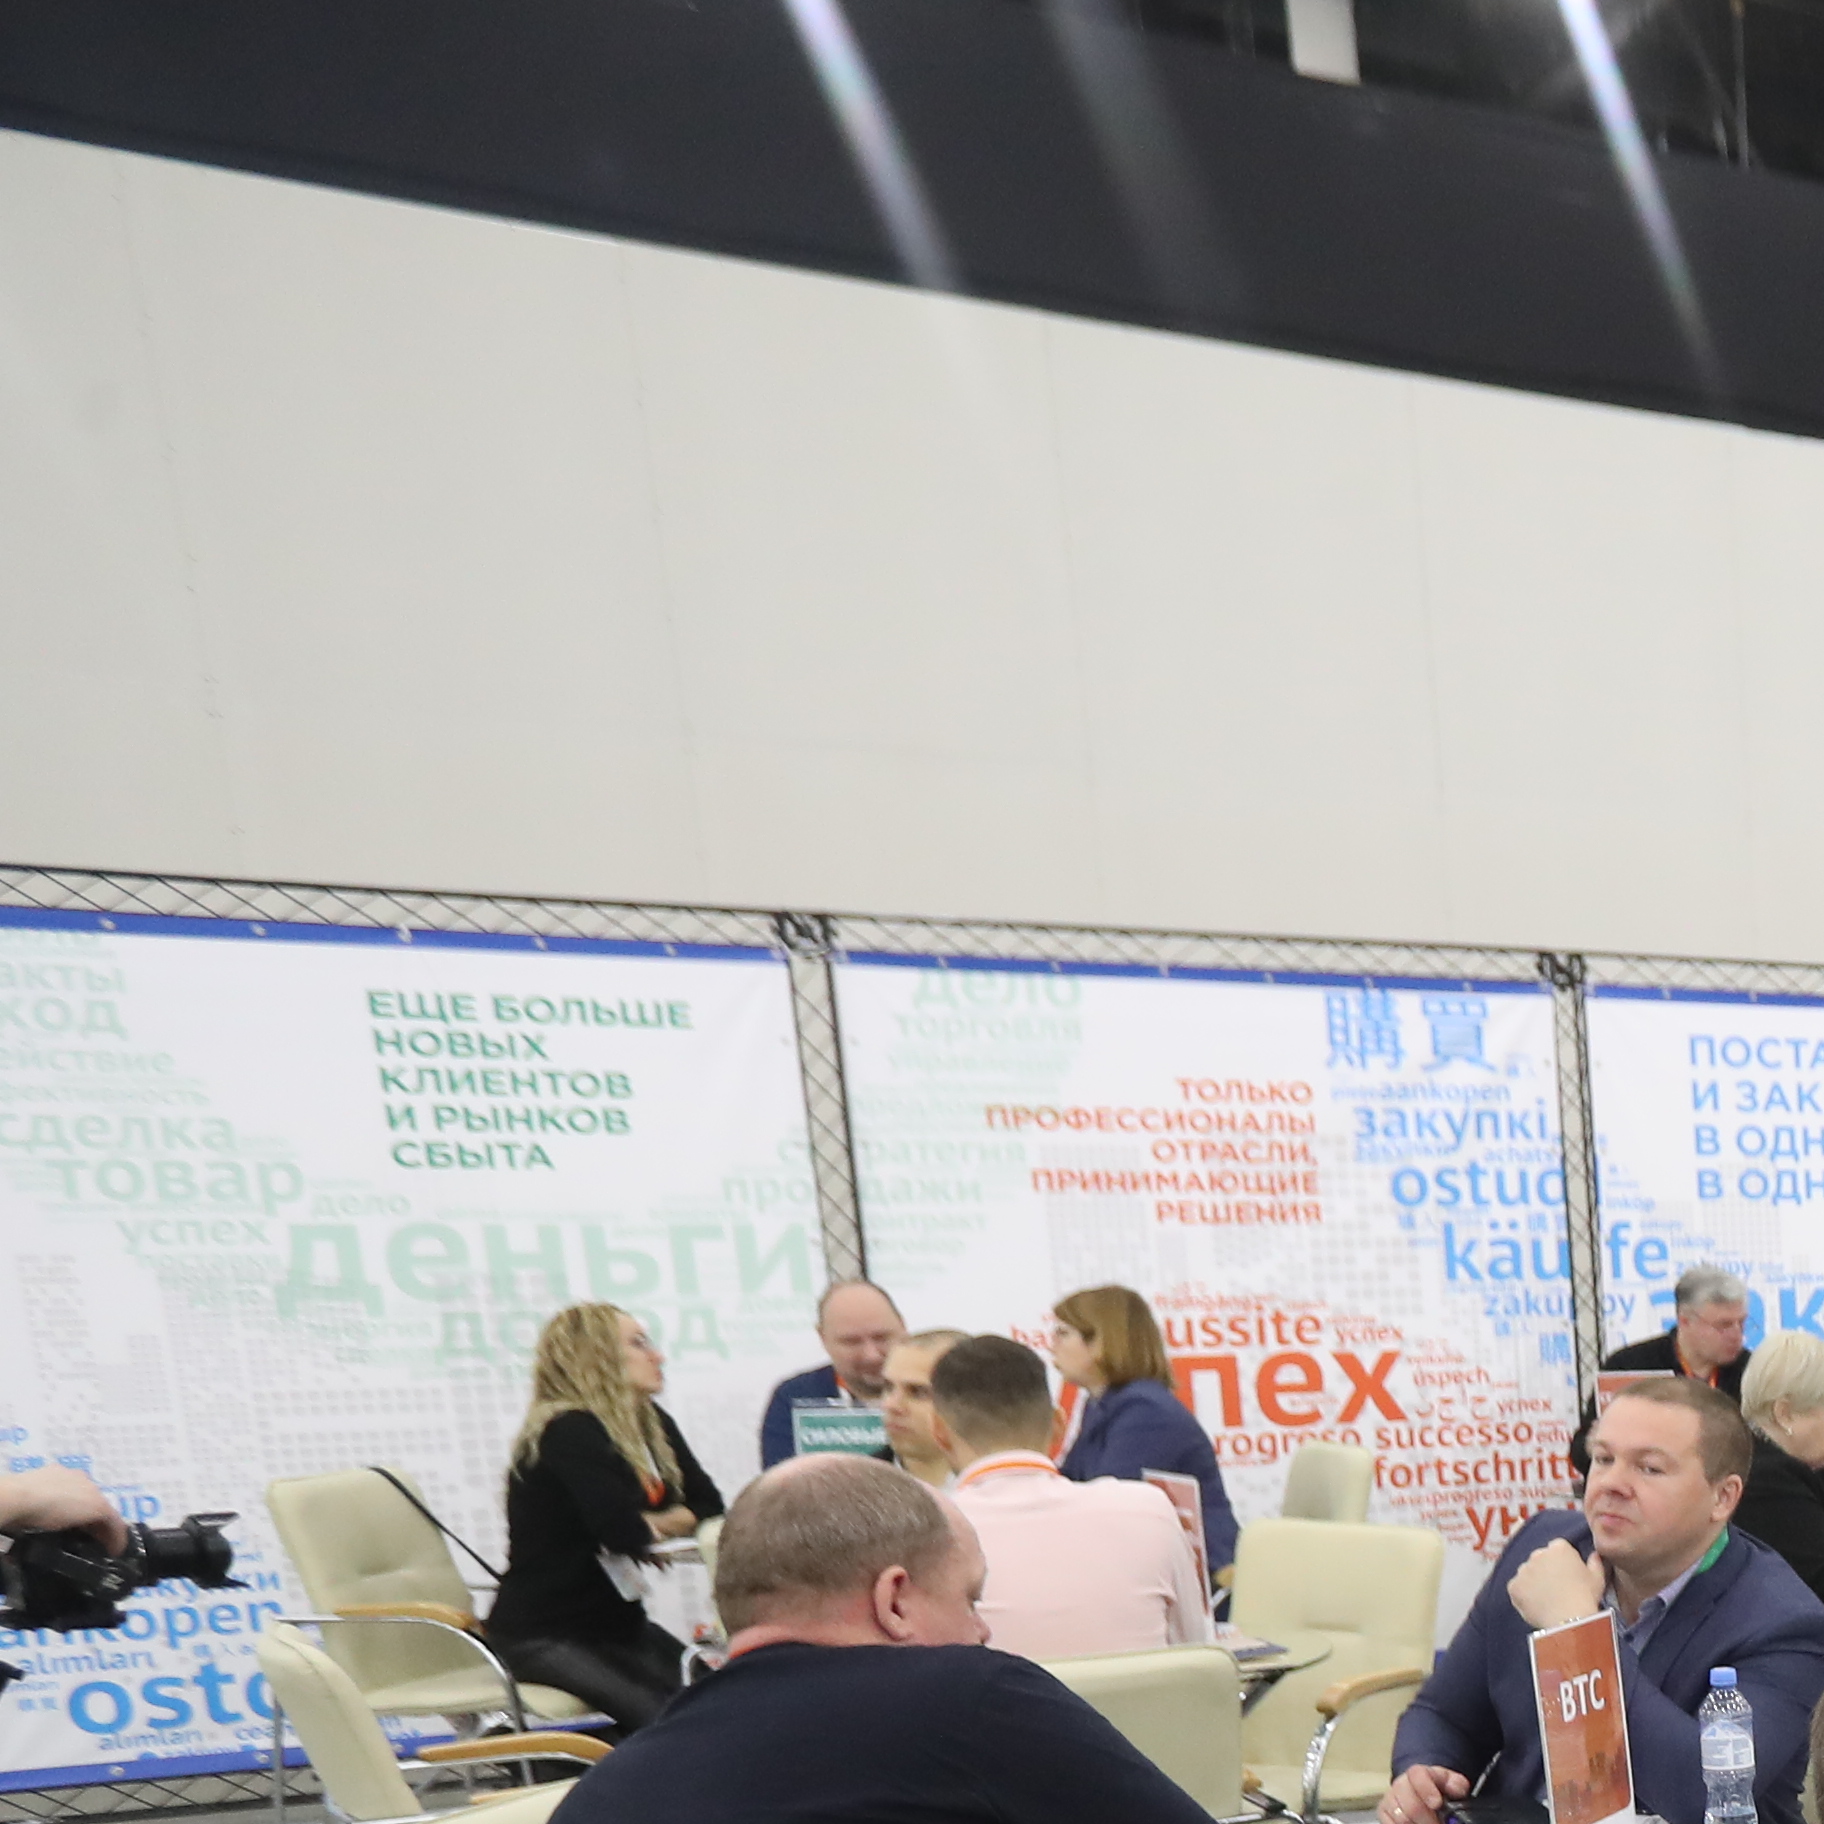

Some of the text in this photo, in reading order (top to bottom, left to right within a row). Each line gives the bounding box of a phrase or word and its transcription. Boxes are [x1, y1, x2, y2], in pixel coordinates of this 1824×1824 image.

[368, 989, 694, 1029] ЕЩЕ БОЛЬШЕ
[373, 1027, 548, 1061] НОВЫХ
[379, 1065, 634, 1100] КЛИЕНТОВ
[1175, 1077, 1314, 1106] ТОЛЬКО
[1692, 1079, 1720, 1111] И
[386, 1104, 631, 1135] И РЫНКОВ
[986, 1104, 1317, 1135] ПРОФЕССИОНАЛЫ
[1151, 1138, 1319, 1168] ОТРАСЛИ,
[1694, 1124, 1720, 1155] В
[392, 1141, 556, 1171] СБЫТА
[46, 1159, 304, 1217] товар
[1031, 1169, 1321, 1200] ПРИНИМАЮЩИЕ
[1697, 1168, 1723, 1200] В
[1155, 1200, 1323, 1226] РЕШЕНИЯ
[274, 1220, 811, 1318] деньги
[1375, 1418, 1534, 1452] successo
